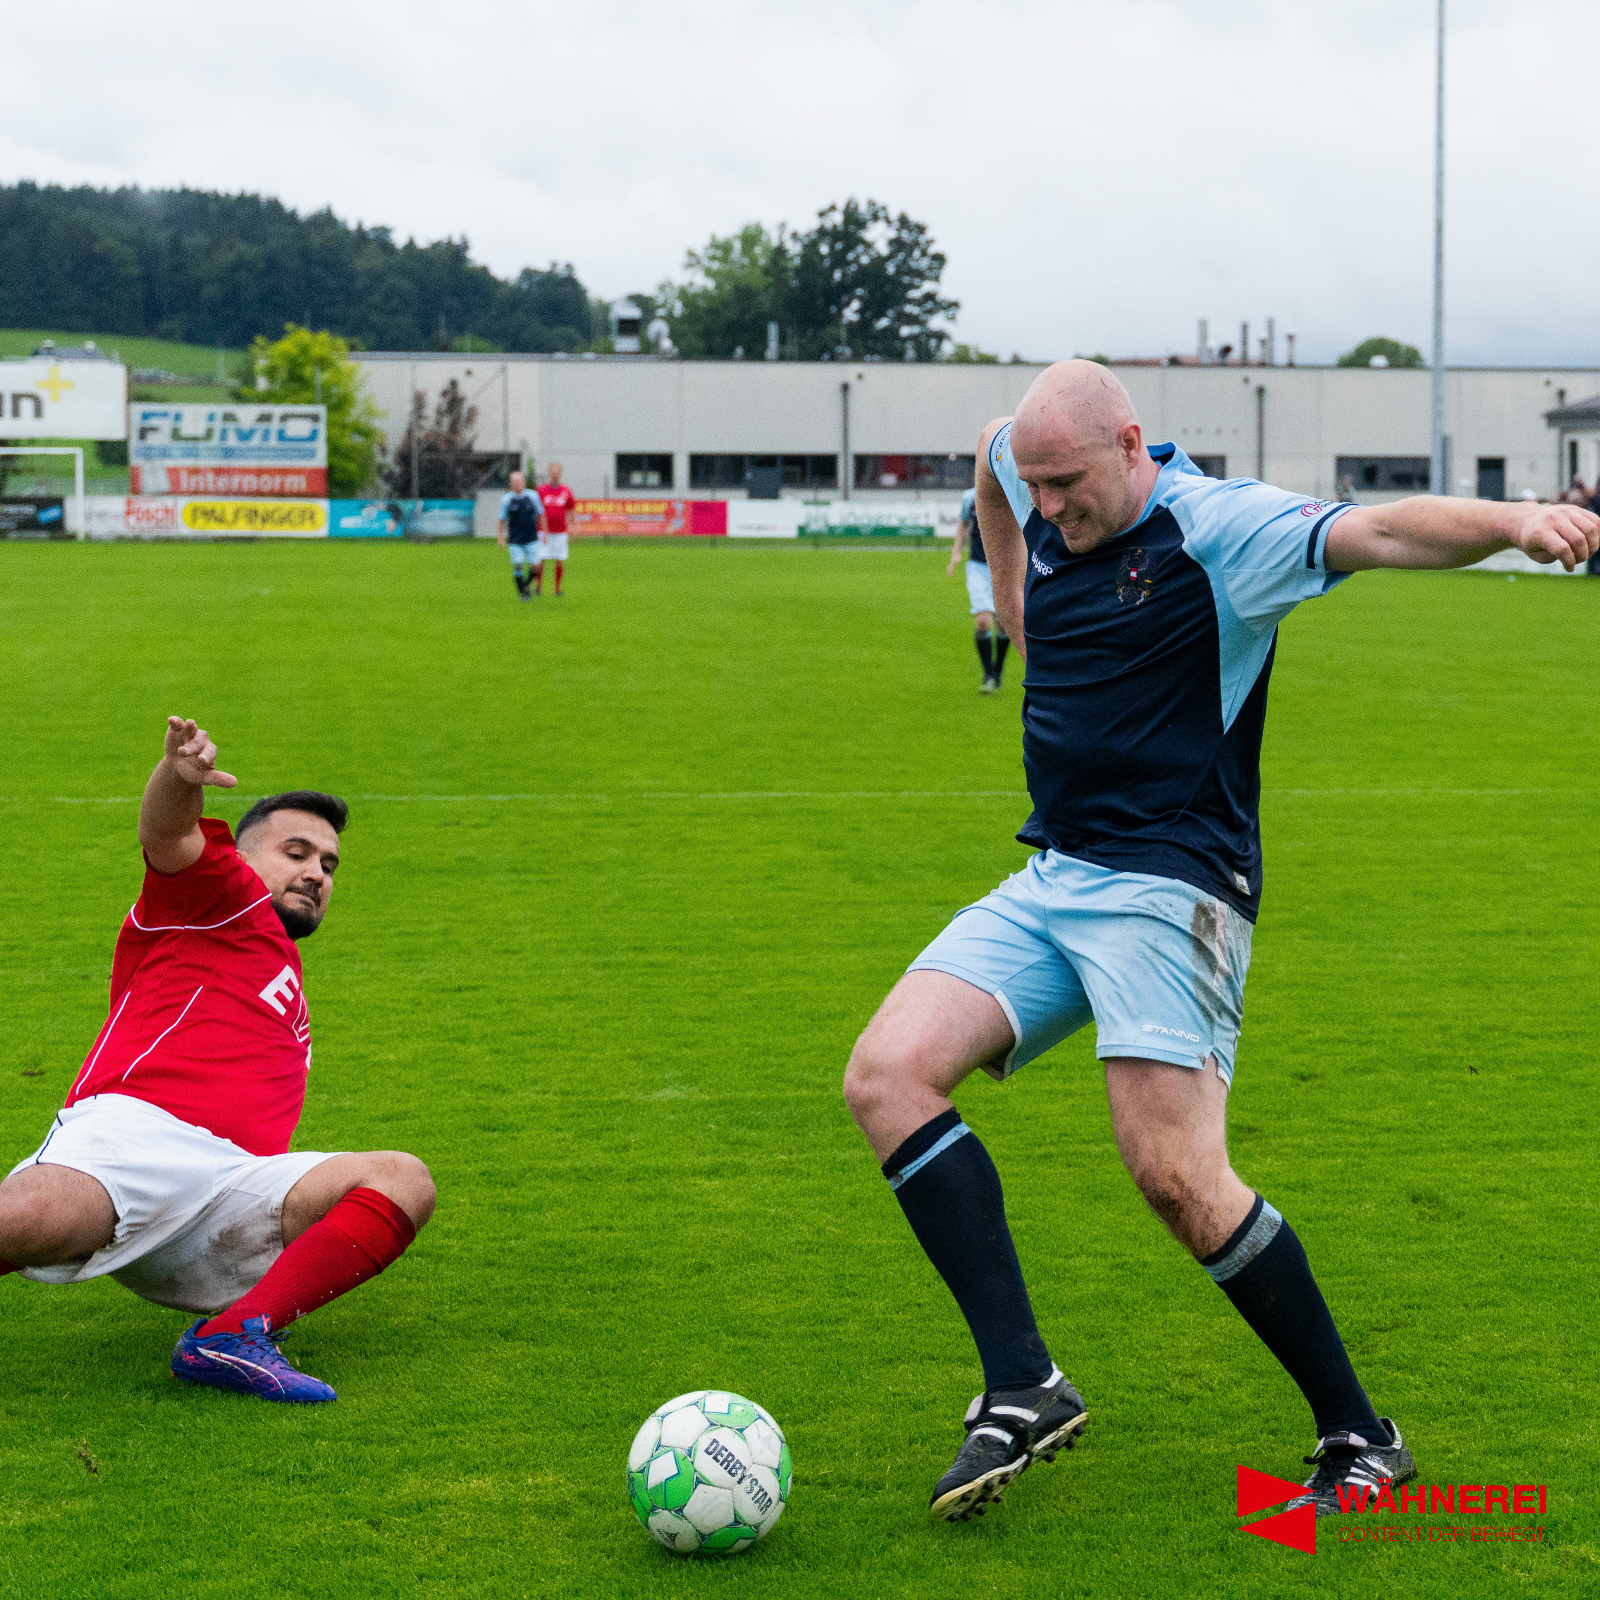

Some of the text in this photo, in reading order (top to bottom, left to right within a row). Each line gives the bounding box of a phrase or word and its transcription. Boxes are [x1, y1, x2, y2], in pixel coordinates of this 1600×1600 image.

[138, 411, 321, 442] FUMO
[180, 470, 307, 493] Internorm
[190, 505, 317, 526] PALFINGER
[1142, 1024, 1200, 1043] STANNO
[704, 1438, 773, 1515] DERBYSTAR
